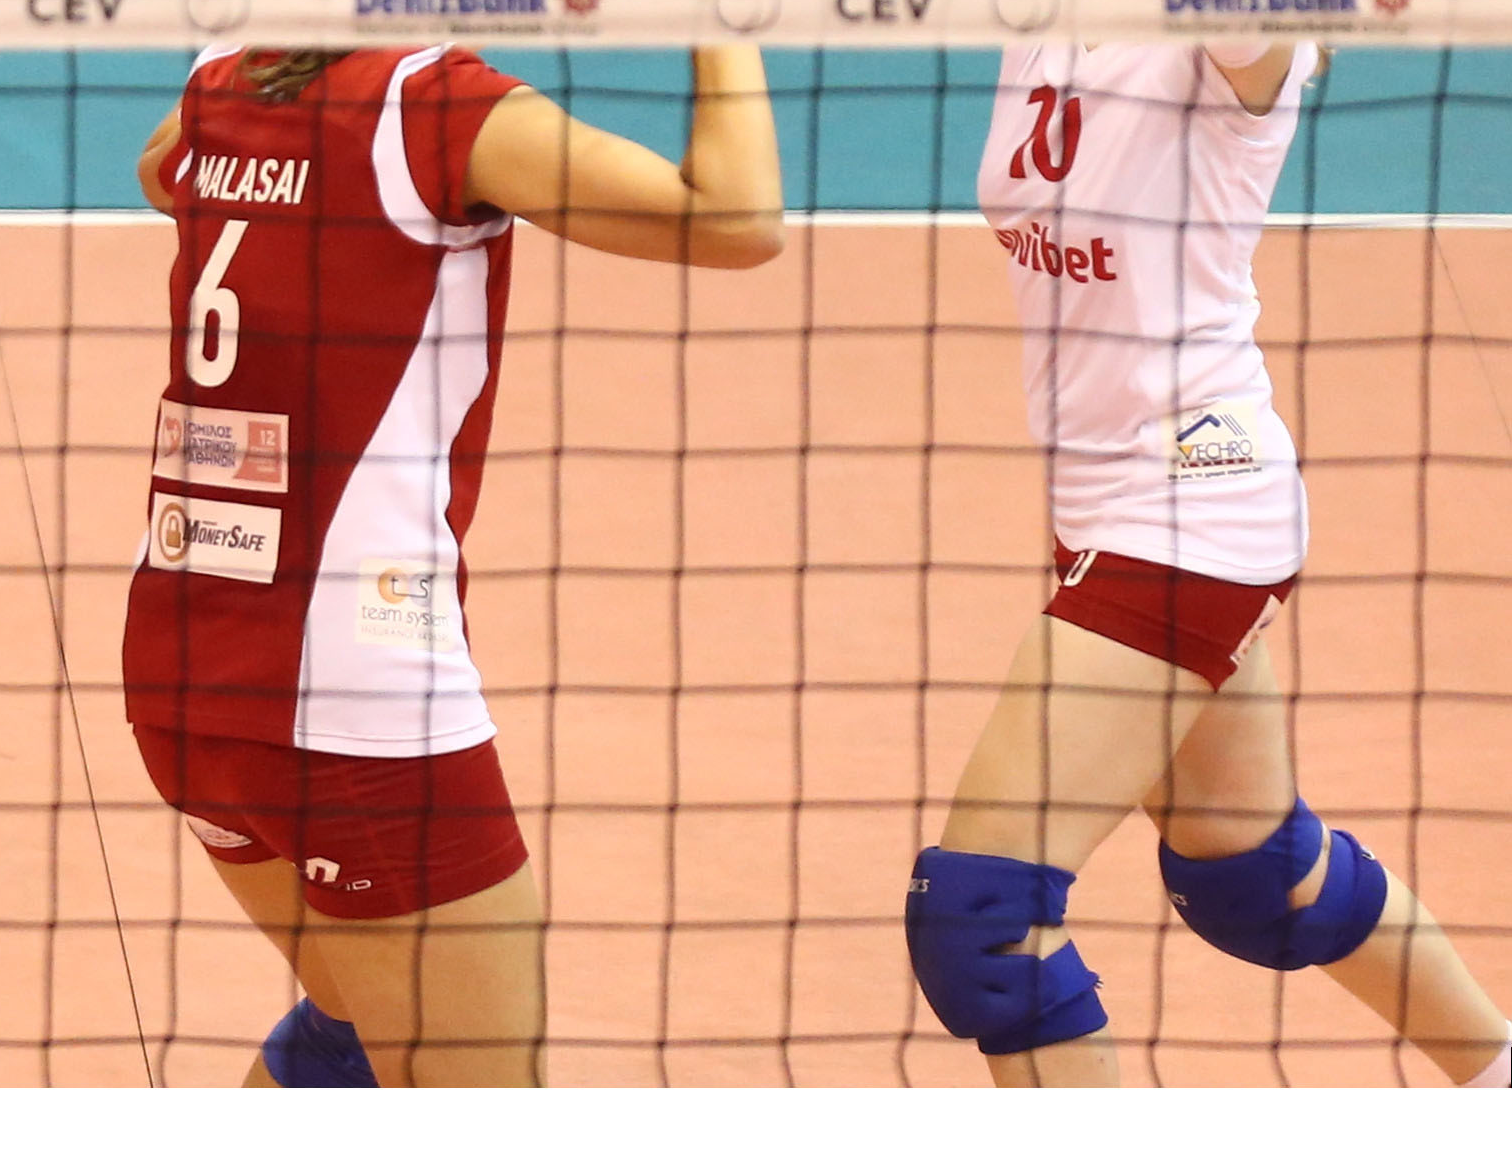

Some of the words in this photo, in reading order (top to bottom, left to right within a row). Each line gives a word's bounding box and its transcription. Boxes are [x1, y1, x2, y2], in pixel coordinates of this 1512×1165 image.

[194, 154, 311, 205] MALASAI
[1009, 84, 1082, 183] 10
[185, 219, 250, 388] 6
